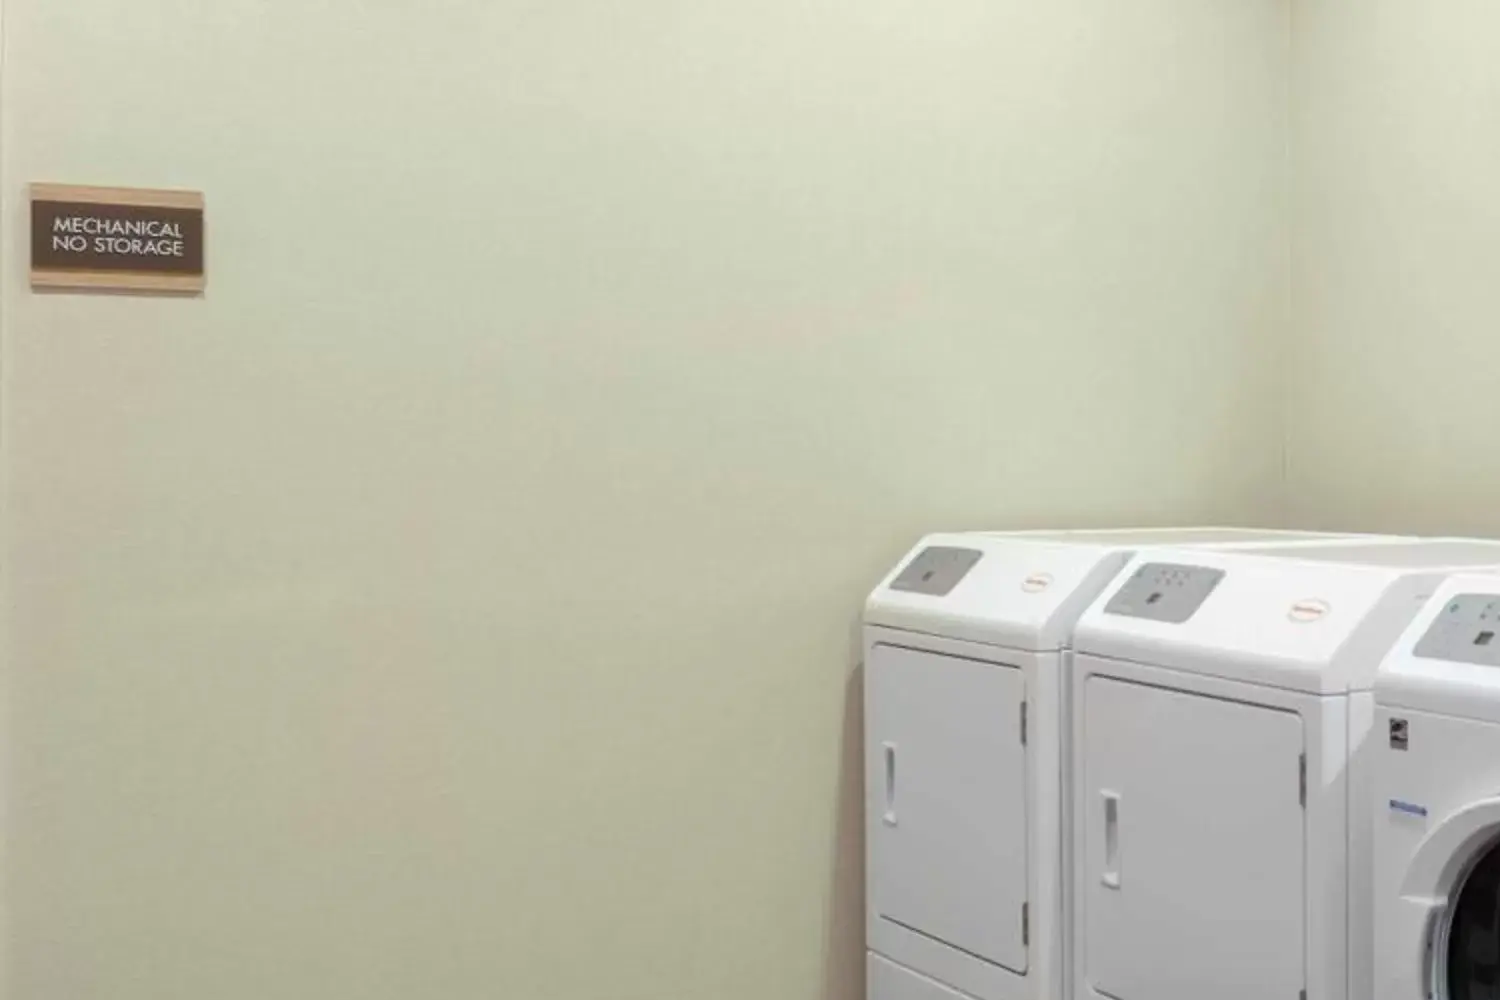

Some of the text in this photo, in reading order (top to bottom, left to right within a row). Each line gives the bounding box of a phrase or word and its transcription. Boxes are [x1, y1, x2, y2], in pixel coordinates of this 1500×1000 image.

[53, 217, 183, 238] MECHANICAL
[53, 236, 184, 256] NO STORAGE
